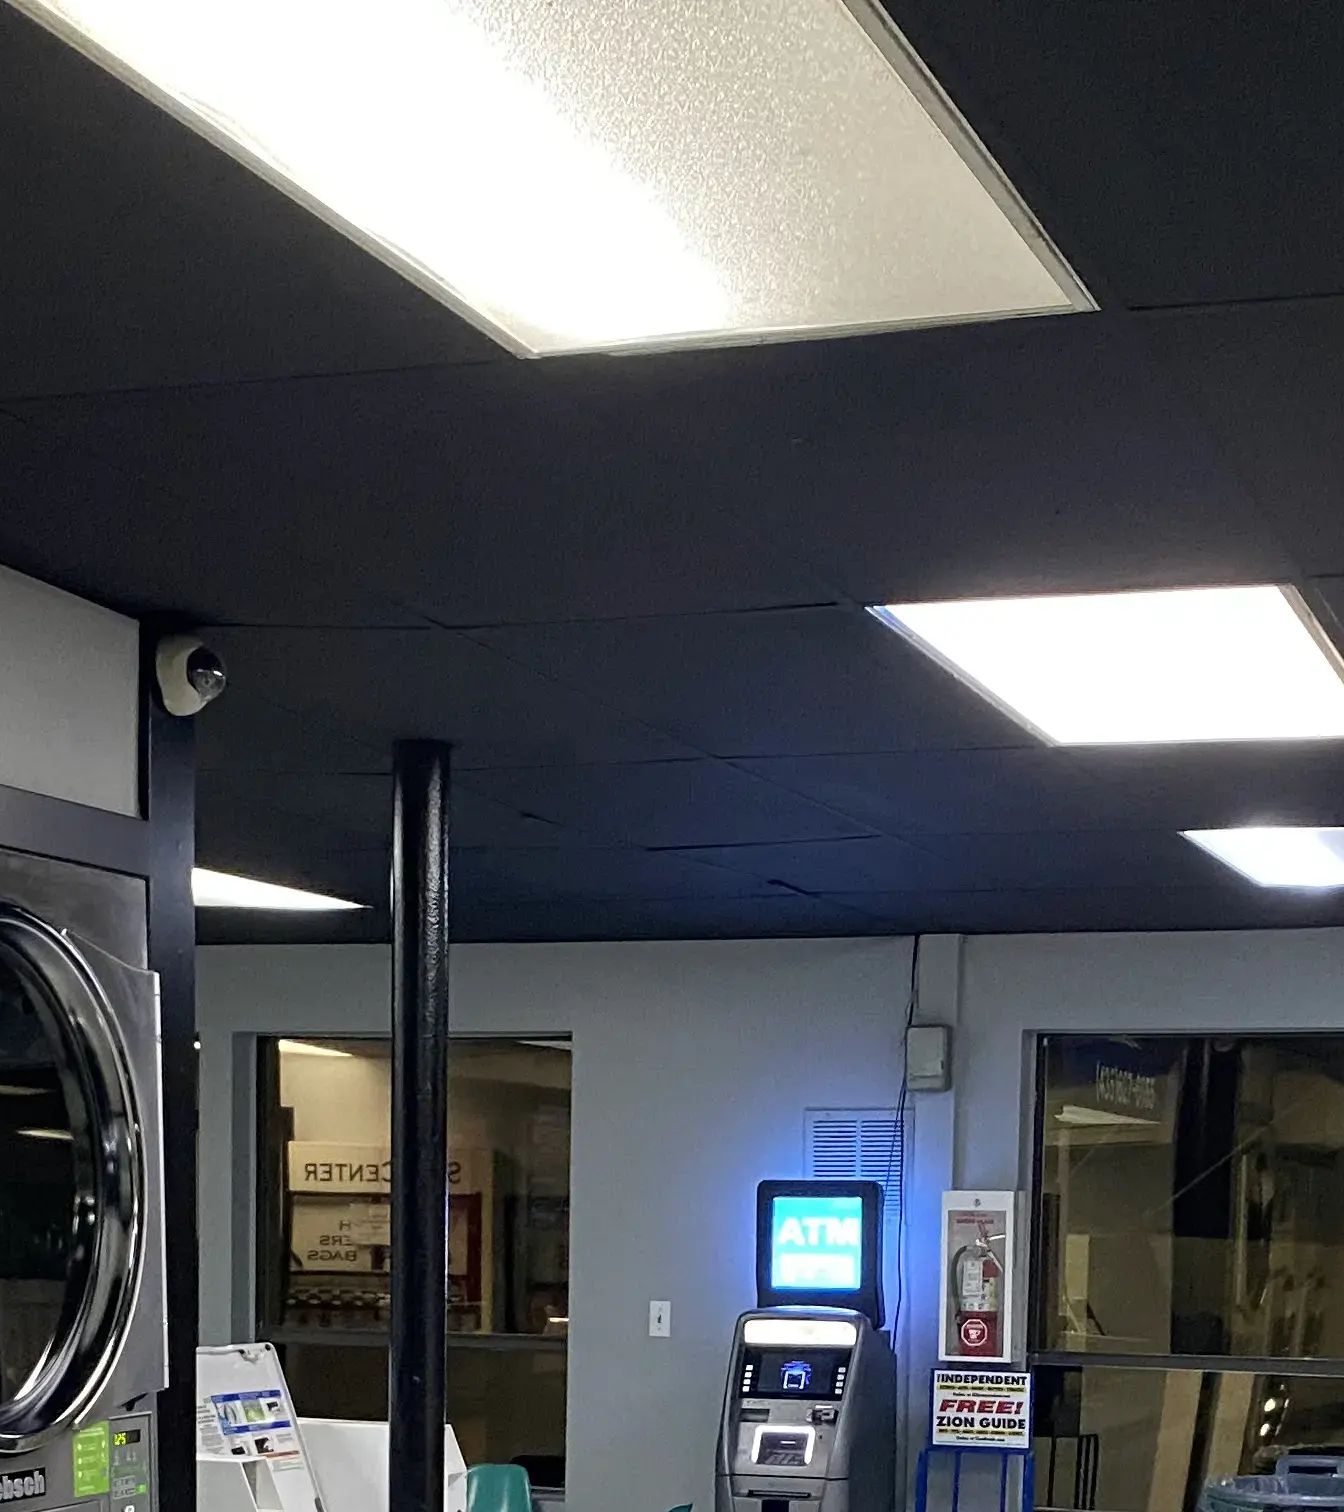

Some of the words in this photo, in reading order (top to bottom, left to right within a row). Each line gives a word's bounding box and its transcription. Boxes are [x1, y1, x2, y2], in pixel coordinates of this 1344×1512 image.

[779, 1216, 860, 1247] ATM
[941, 1373, 1028, 1386] INDEPENDENT
[939, 1399, 1024, 1415] FREE!
[936, 1415, 975, 1428] ZION
[979, 1417, 1026, 1430] GUIDE
